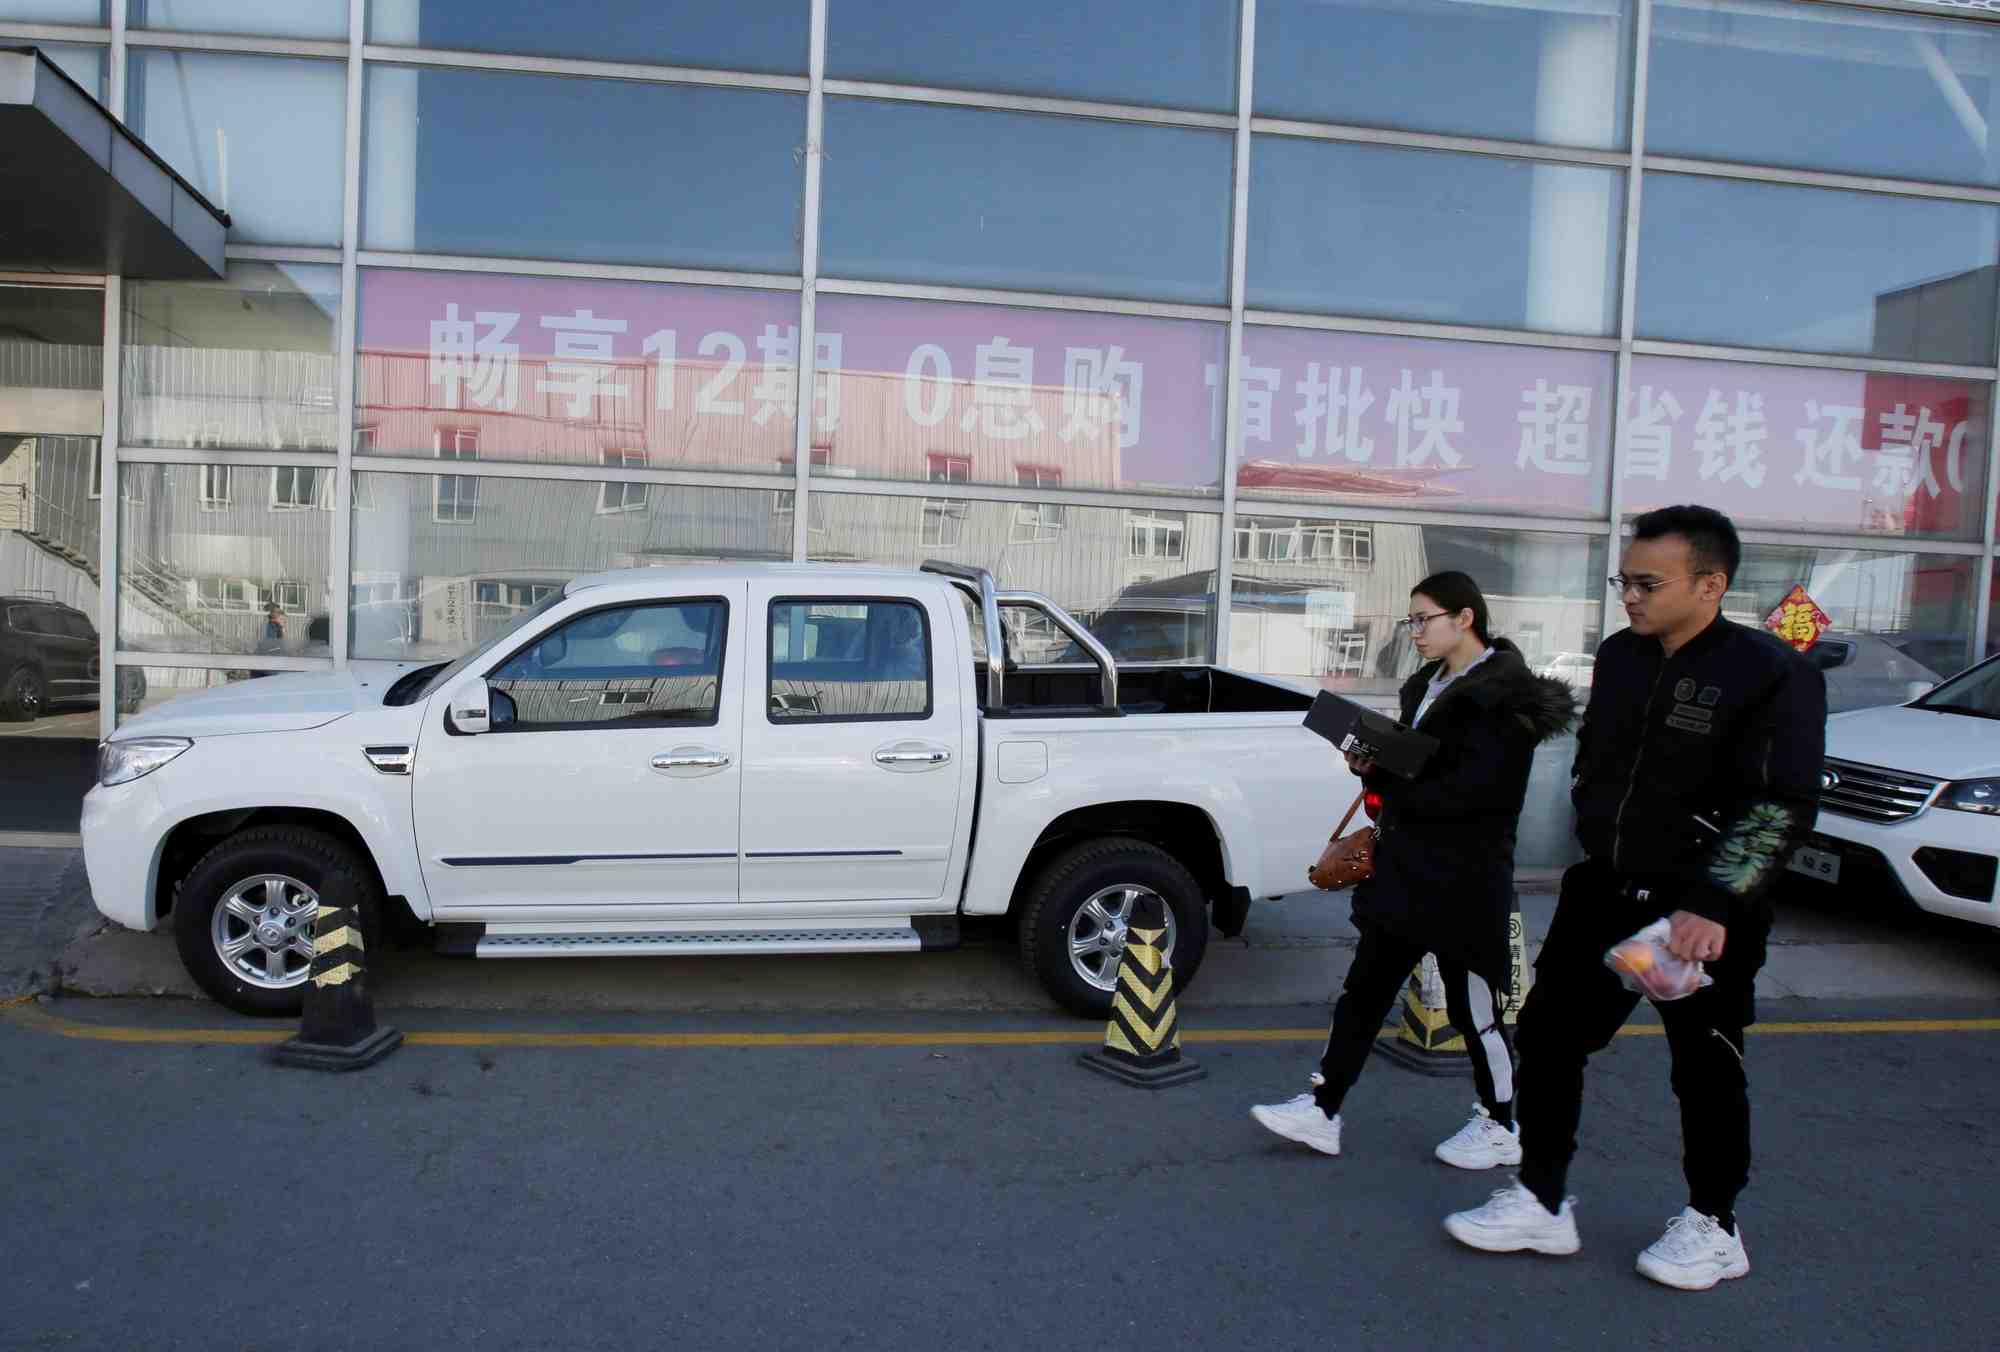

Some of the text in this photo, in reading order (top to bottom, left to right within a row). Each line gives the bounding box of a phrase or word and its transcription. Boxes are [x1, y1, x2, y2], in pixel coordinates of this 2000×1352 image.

[430, 303, 843, 432] 畅享12期
[905, 337, 1144, 449] 0息购
